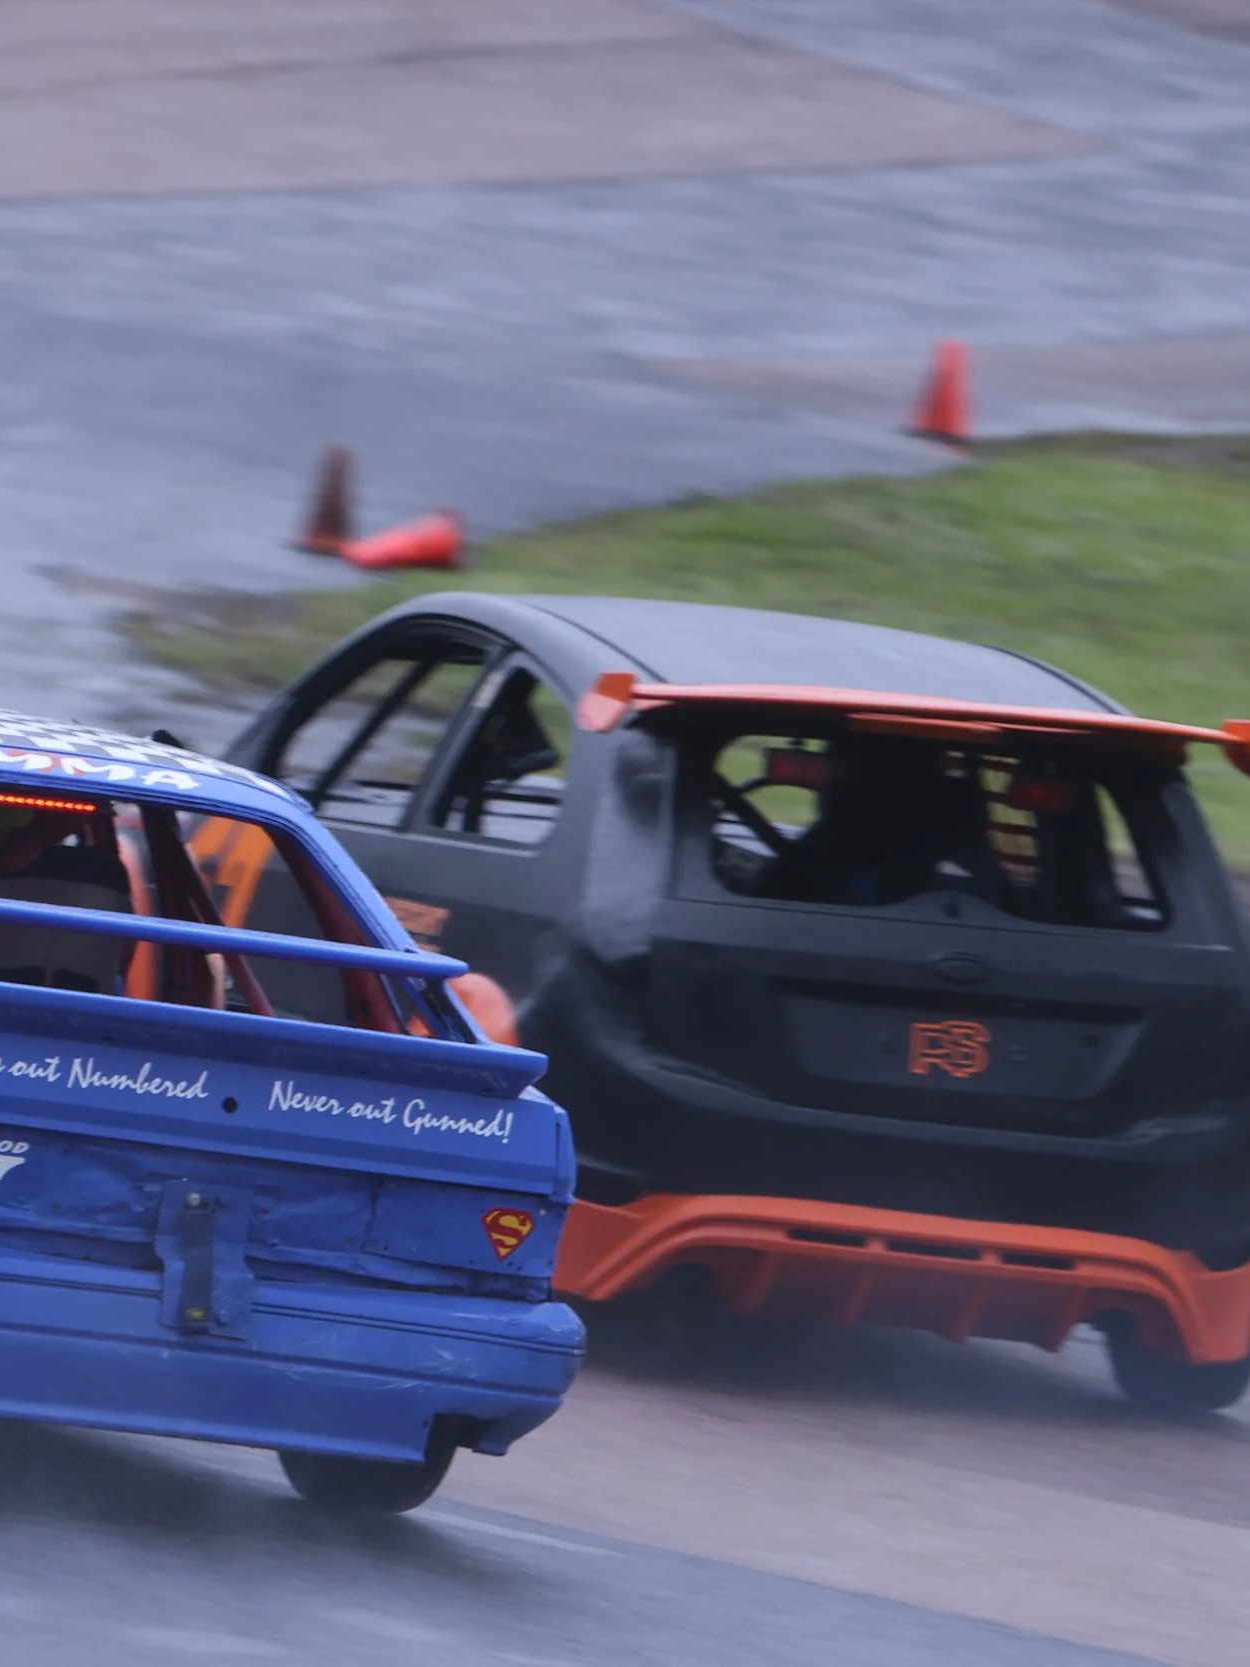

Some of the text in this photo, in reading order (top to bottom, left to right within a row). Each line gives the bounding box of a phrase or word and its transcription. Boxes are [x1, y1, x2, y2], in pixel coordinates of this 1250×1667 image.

[8, 1056, 62, 1082] out
[67, 1058, 210, 1100] Numbered
[268, 1080, 344, 1115] Never
[347, 1098, 398, 1124] out
[403, 1098, 514, 1144] Gunned!
